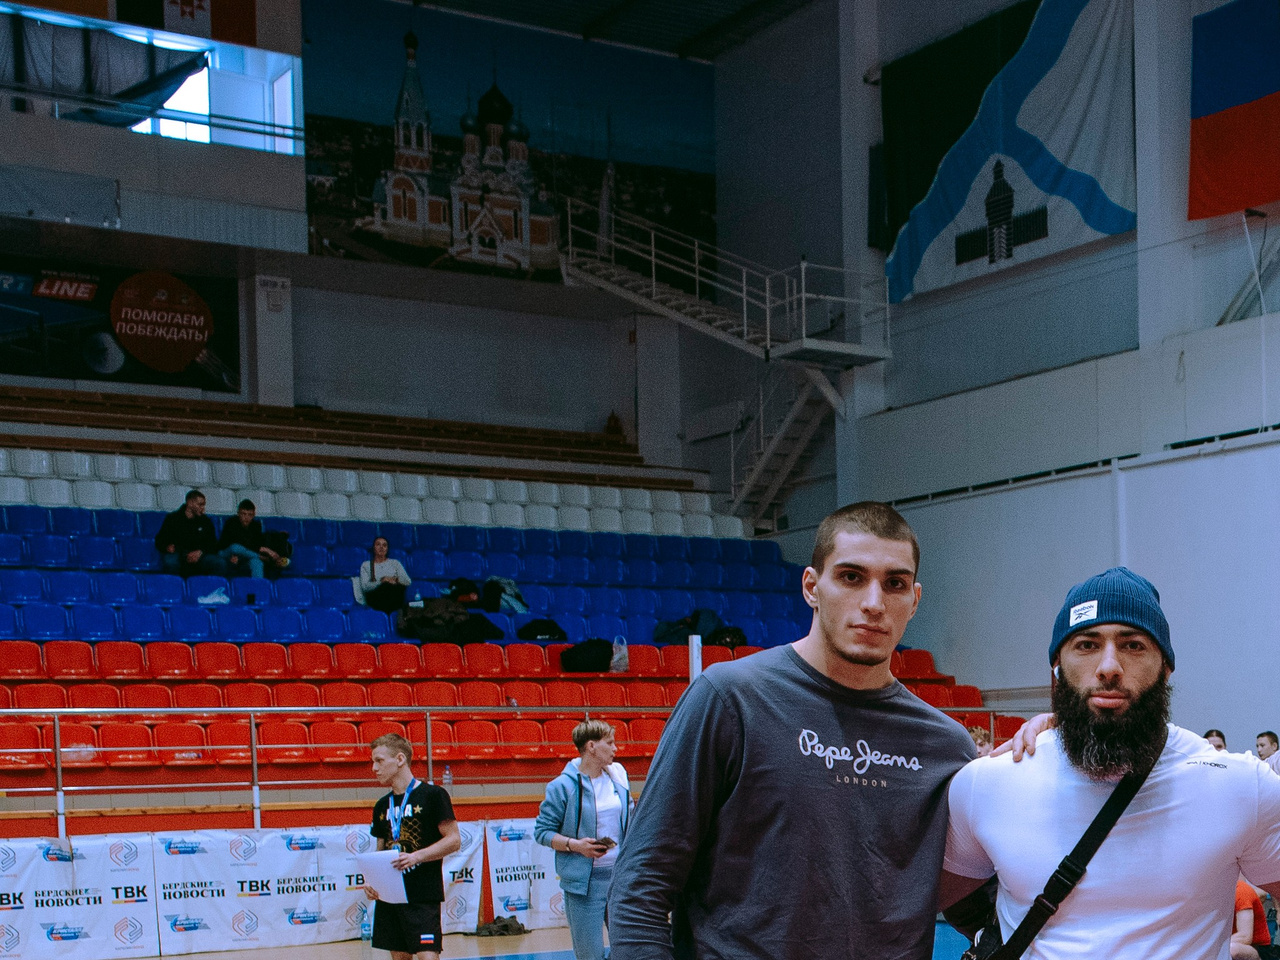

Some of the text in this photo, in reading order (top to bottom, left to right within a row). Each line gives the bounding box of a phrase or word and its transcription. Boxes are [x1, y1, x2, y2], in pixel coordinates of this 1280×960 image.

[38, 280, 90, 298] LINE
[121, 307, 205, 327] ПОМОГАЕМ
[116, 322, 209, 342] ПОБЕЖДАТЬ!
[798, 728, 923, 775] Pepe Jeans
[836, 774, 887, 788] LONDON
[162, 881, 210, 890] БЕРДСКИЕ
[236, 879, 271, 892] ТВК
[276, 876, 320, 885] БЕРДСКИЕ
[345, 874, 365, 886] ТВ
[34, 888, 85, 898] БЕРДСКИЕ
[111, 885, 148, 899] ТВК
[163, 888, 226, 900] НОВОСТИ
[276, 883, 337, 895] НОВОСТИ
[0, 892, 24, 905] ВК
[35, 895, 103, 908] НОВОСТИ
